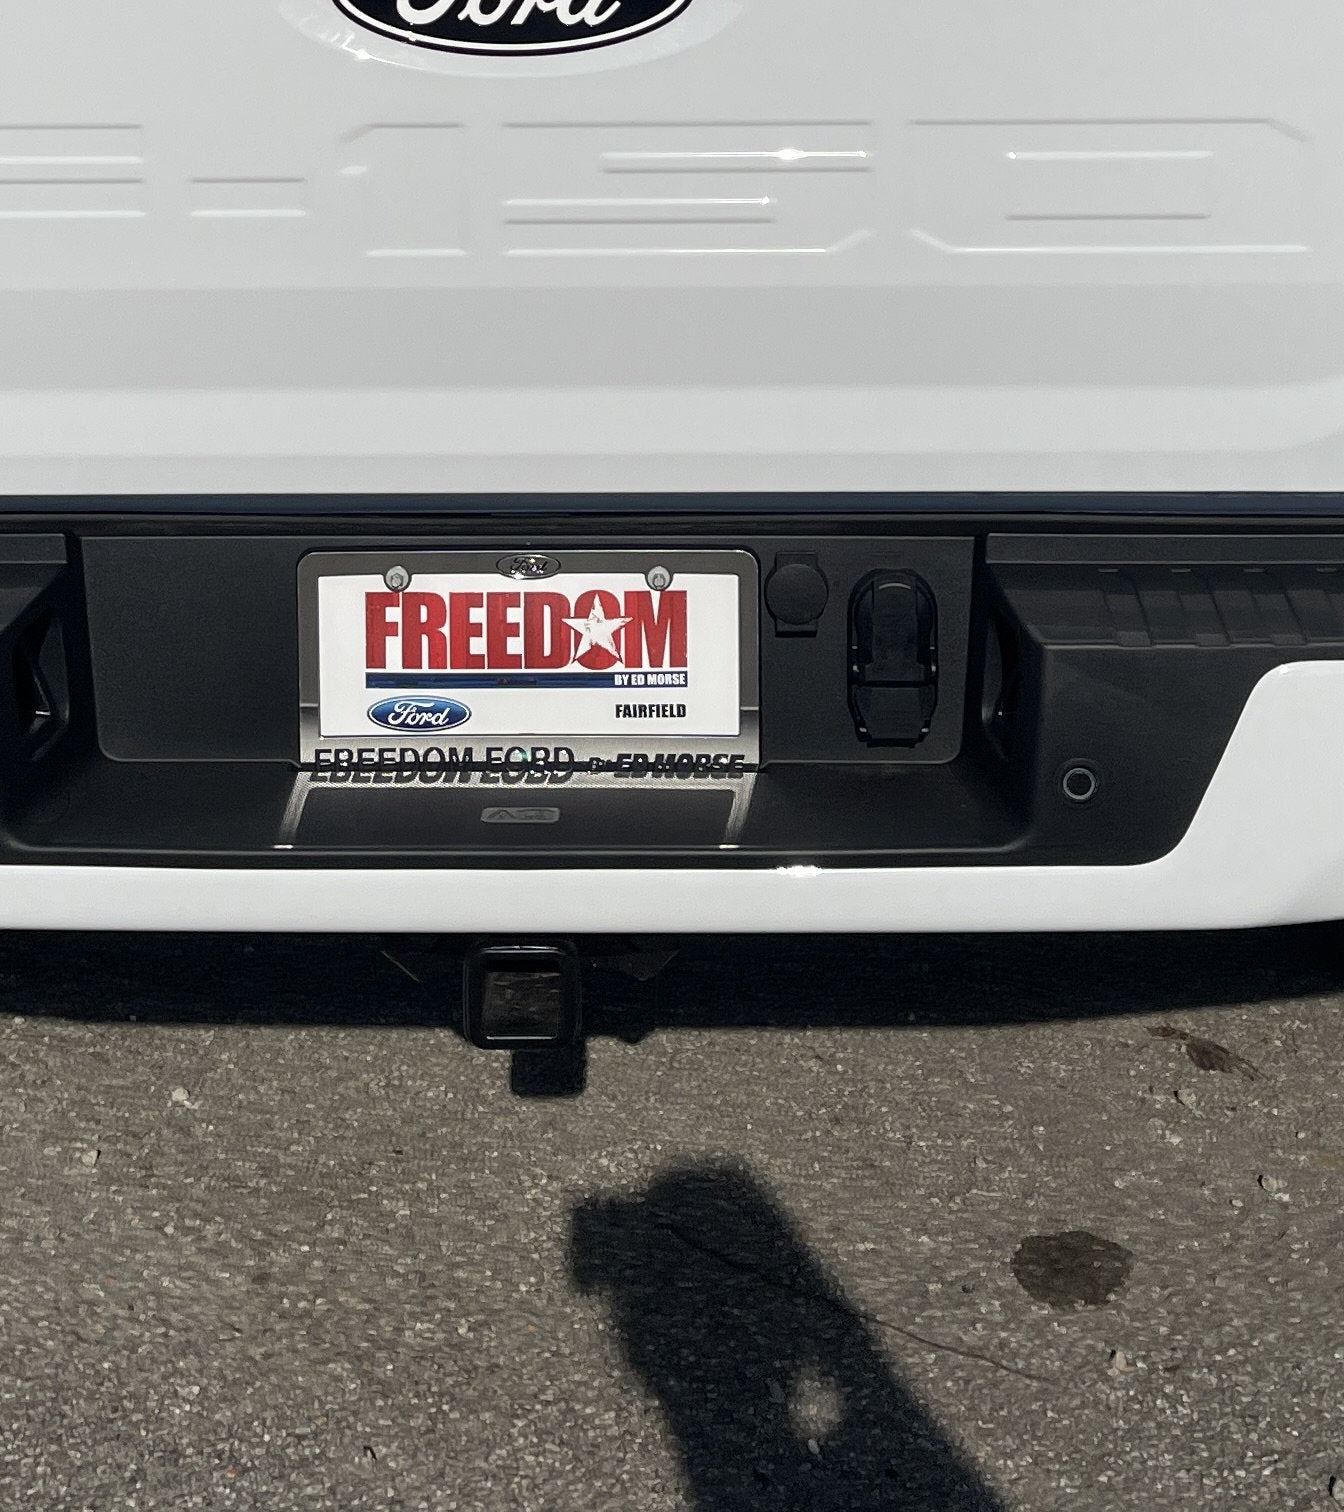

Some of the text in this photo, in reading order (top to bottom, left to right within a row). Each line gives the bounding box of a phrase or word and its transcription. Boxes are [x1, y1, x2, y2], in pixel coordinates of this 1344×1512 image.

[365, 589, 688, 671] FREEDOM
[614, 674, 686, 686] BY ED MORSE
[388, 701, 450, 726] Ford
[615, 704, 687, 718] FAIRFIELD
